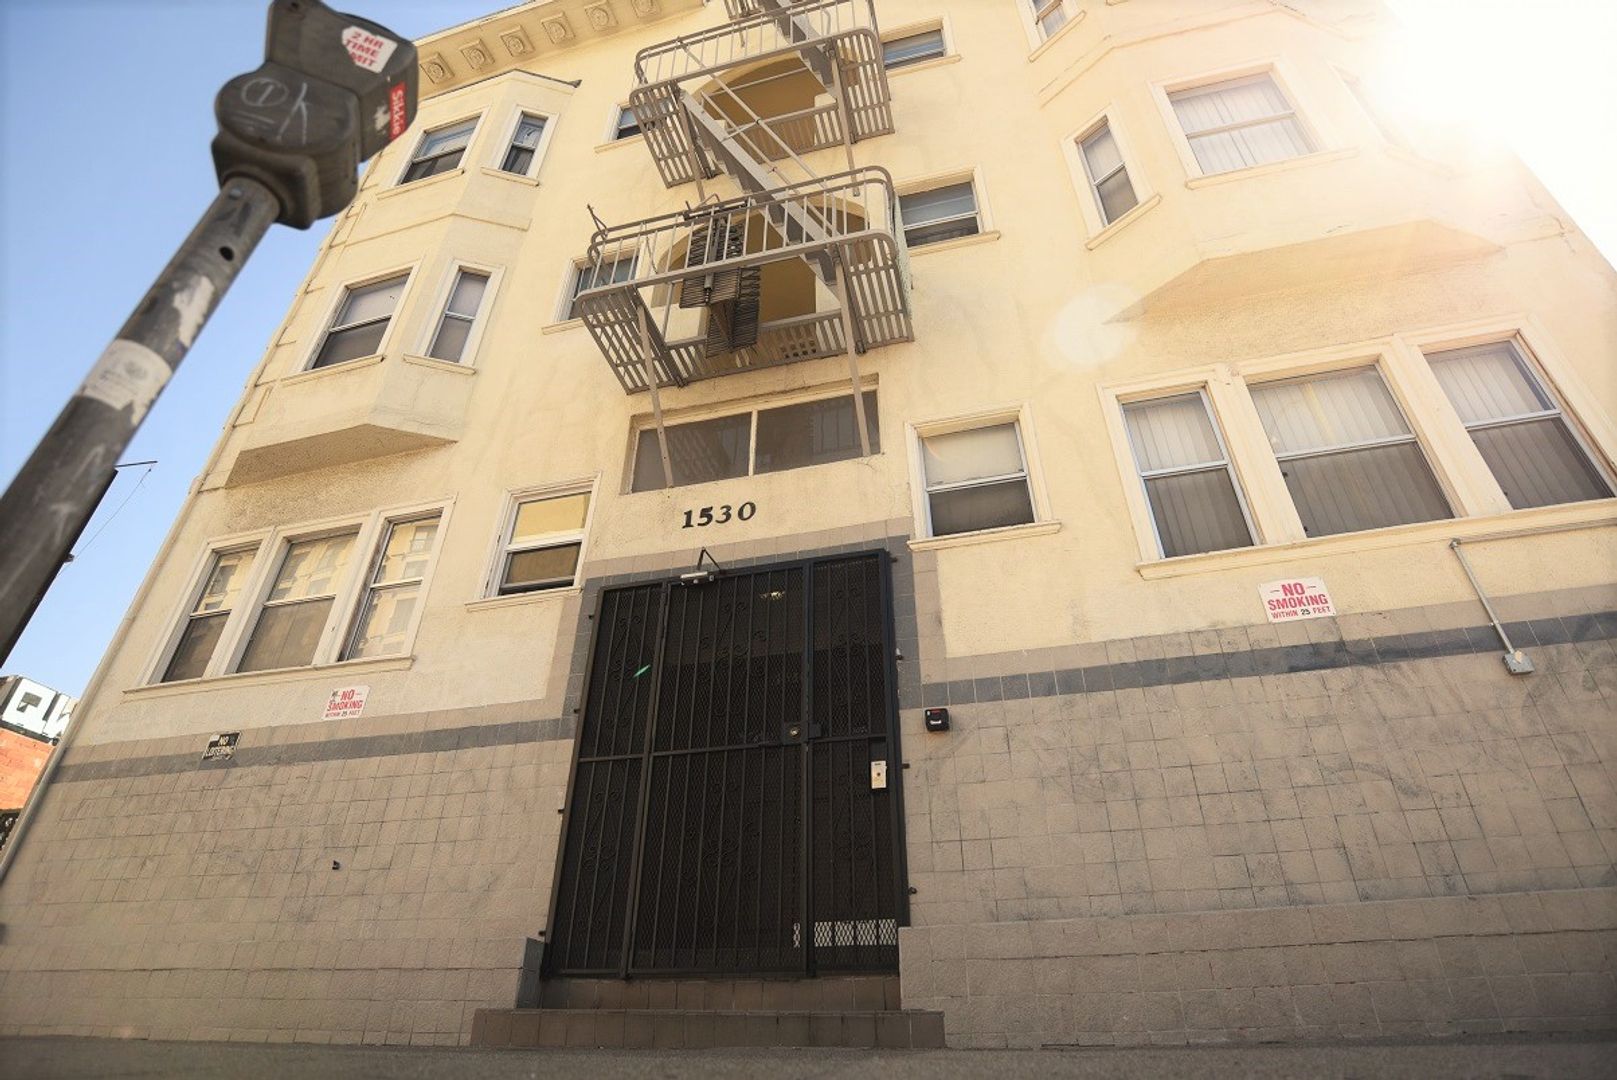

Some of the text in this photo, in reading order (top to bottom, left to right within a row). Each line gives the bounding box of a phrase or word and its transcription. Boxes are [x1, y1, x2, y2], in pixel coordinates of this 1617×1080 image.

[346, 38, 379, 58] TIME
[364, 35, 384, 49] HR
[681, 501, 757, 529] 1530
[1281, 582, 1306, 597] NO
[1267, 593, 1329, 611] SMOKING
[1271, 606, 1331, 619] WITHIN 25 FEET
[340, 689, 355, 701] NO
[327, 699, 363, 712] SMOKING
